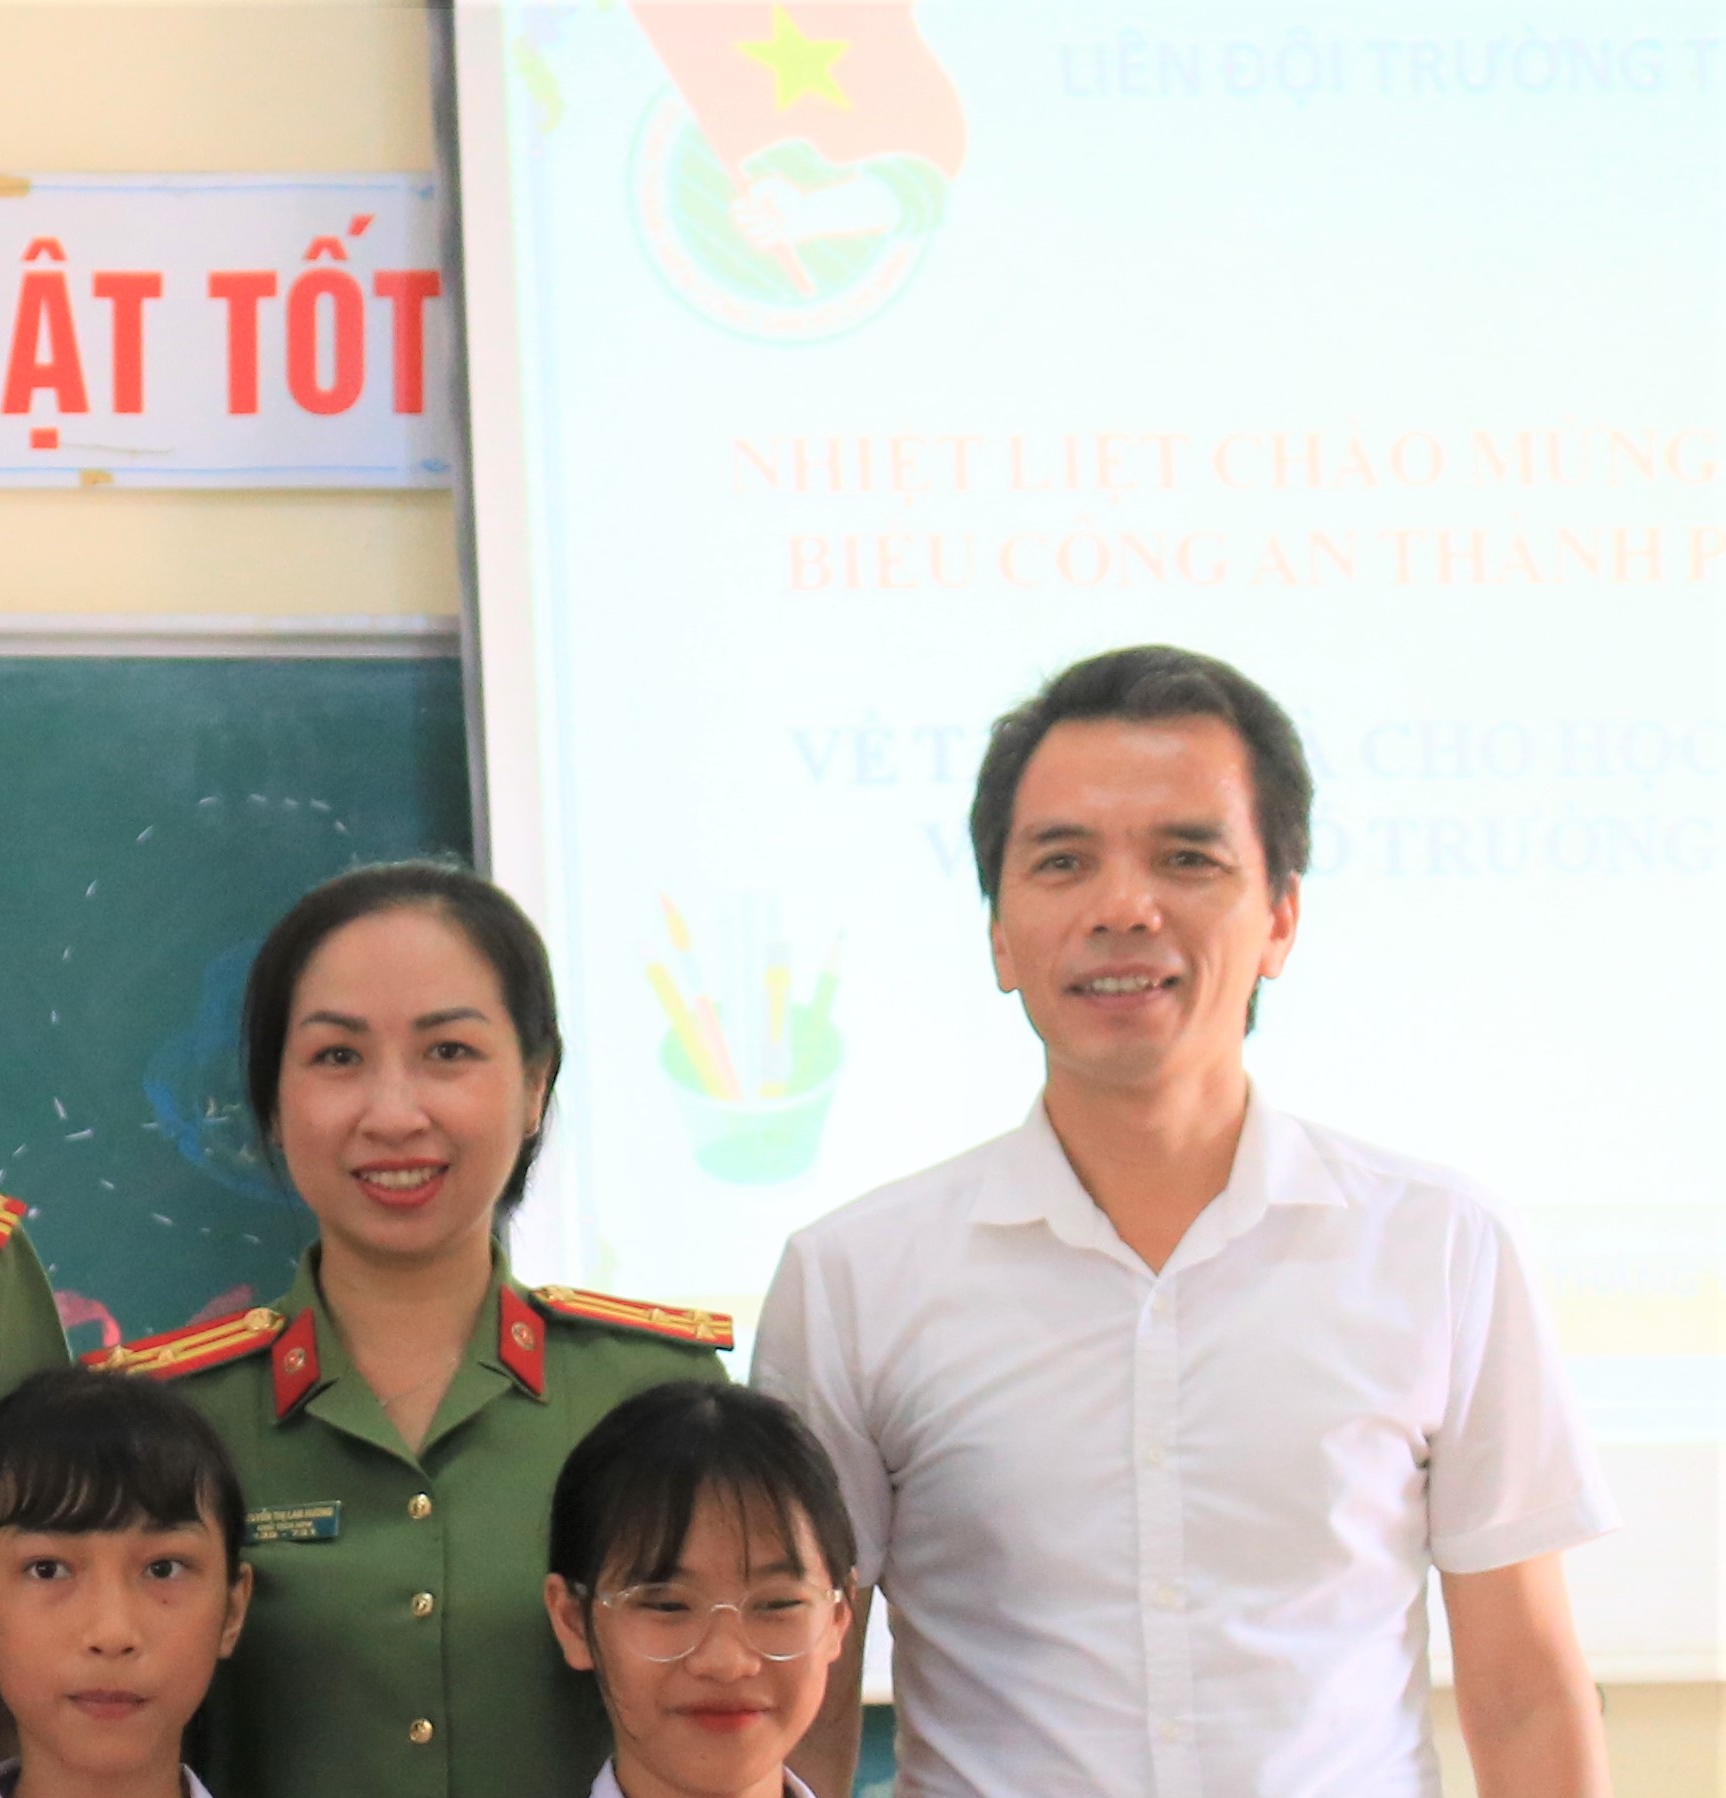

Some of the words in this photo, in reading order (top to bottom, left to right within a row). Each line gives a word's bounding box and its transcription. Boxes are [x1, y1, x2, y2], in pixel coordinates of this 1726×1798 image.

[1061, 24, 1201, 97] LIÊN
[1225, 25, 1347, 107] ĐỘI
[1364, 24, 1664, 95] TRƯỜNG
[207, 214, 442, 416] TỐT
[731, 418, 987, 509] NHIỆT
[1007, 420, 1190, 509] LIỆT
[996, 512, 1229, 590] CÔNG
[1248, 526, 1358, 588] AN
[1378, 511, 1668, 586] THÀNH
[1361, 720, 1537, 779] CHO
